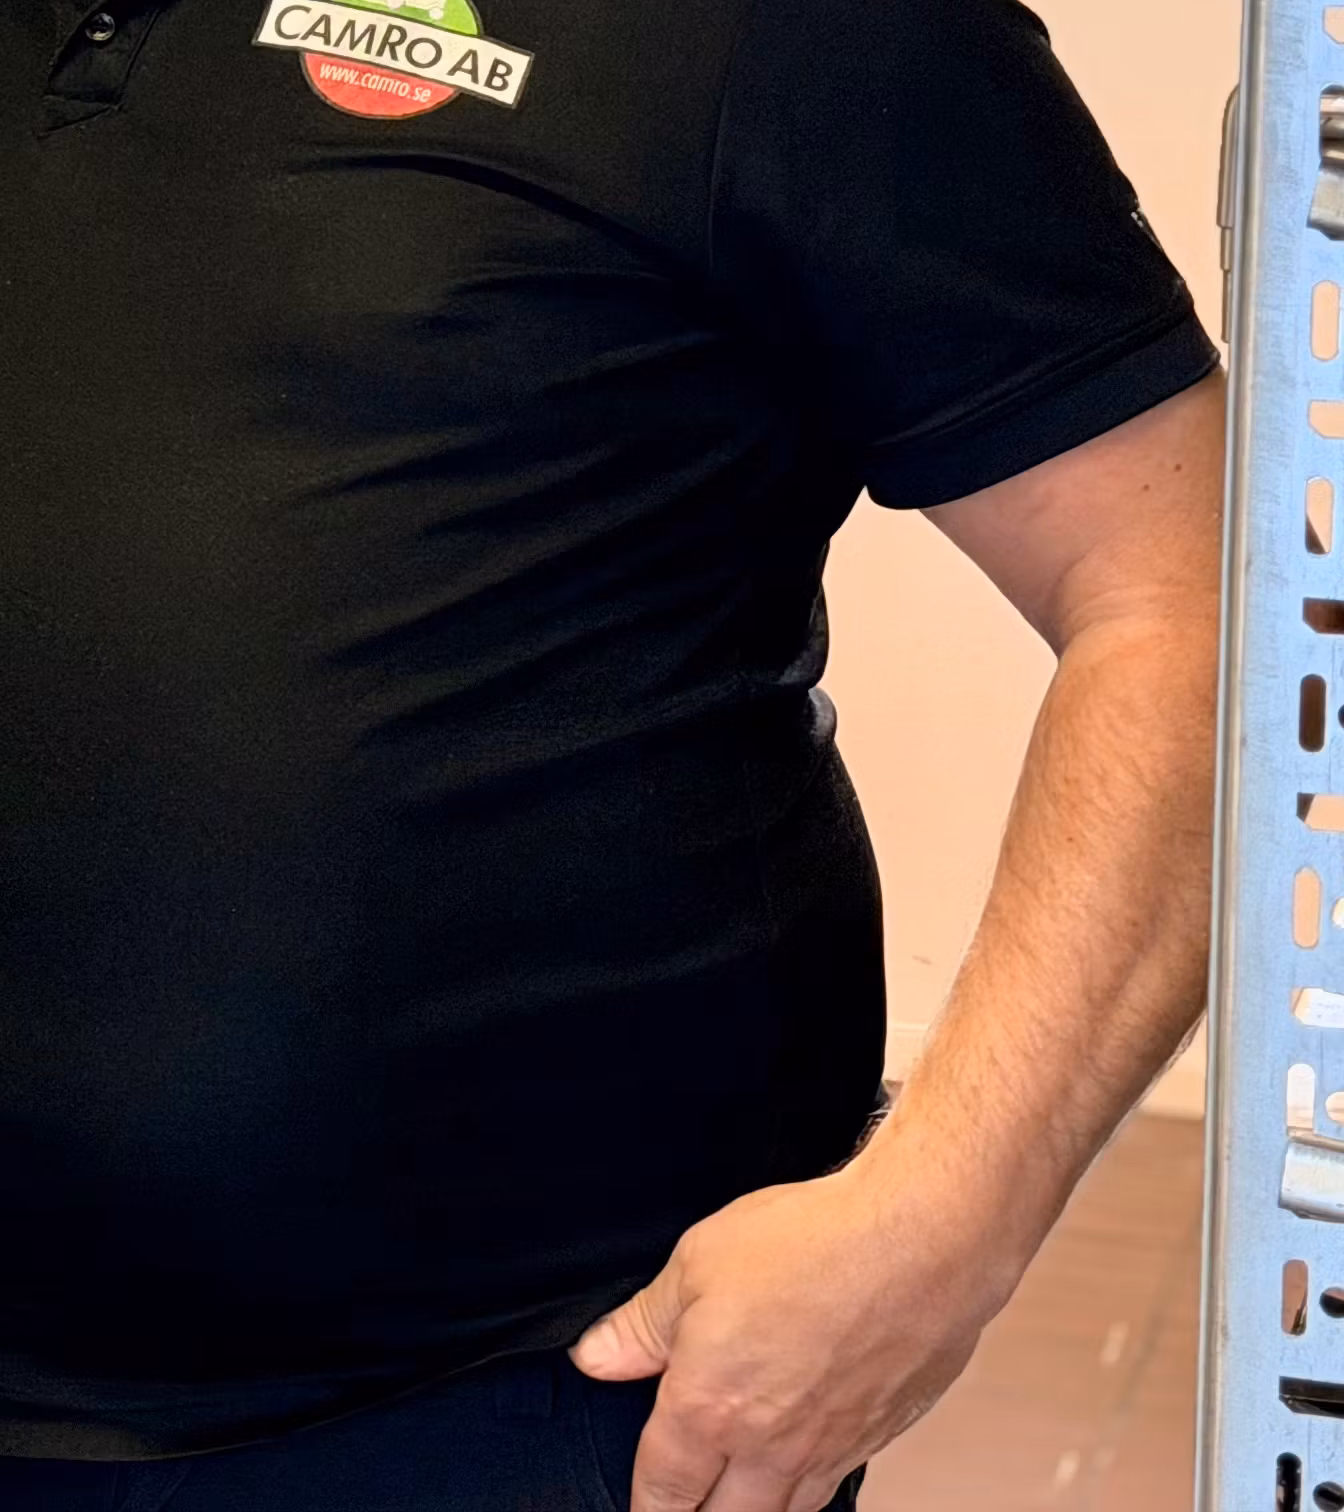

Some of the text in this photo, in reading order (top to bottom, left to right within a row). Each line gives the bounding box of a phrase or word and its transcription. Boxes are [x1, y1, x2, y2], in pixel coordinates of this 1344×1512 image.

[273, 4, 514, 92] CAMRO AB
[319, 61, 432, 104] www.camro.se
